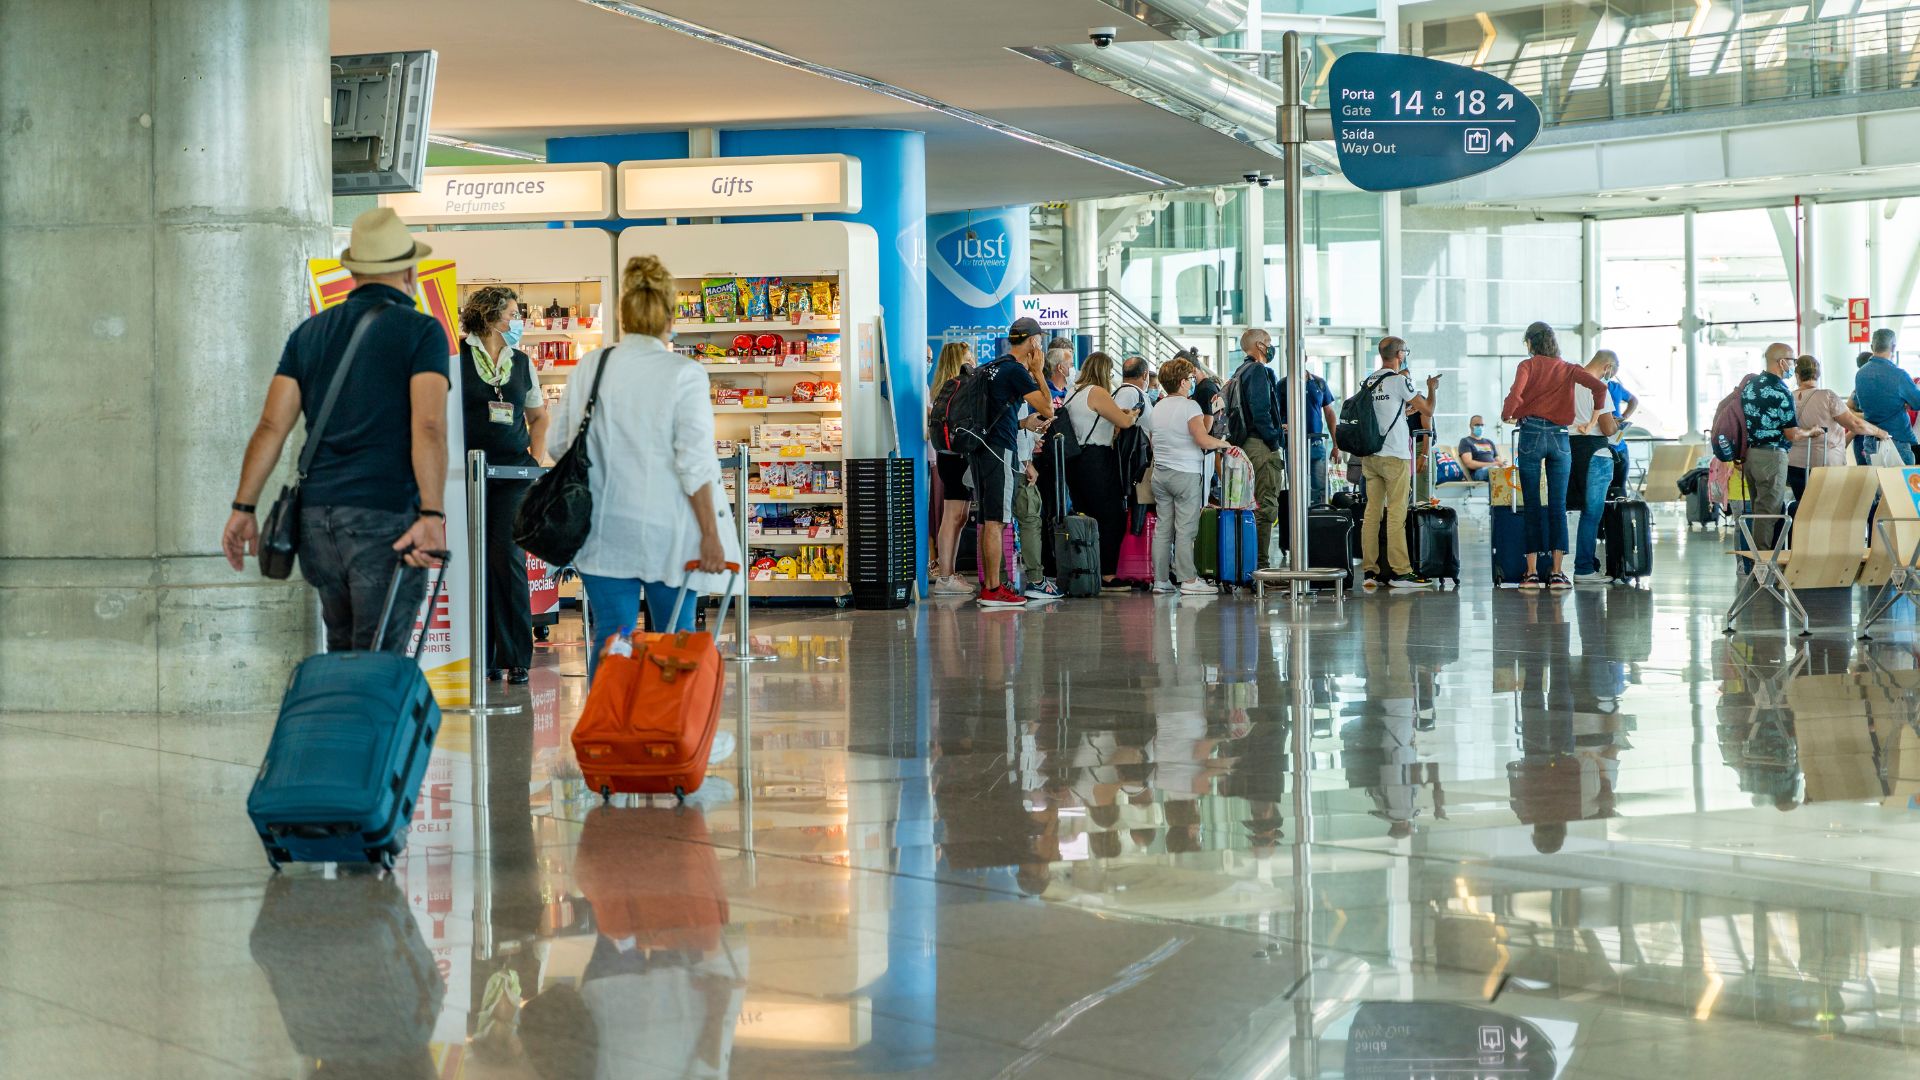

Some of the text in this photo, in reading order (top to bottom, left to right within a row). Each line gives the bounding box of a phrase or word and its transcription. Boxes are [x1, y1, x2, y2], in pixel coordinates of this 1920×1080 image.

[1342, 88, 1486, 115] Porta 14 a 18
[1342, 105, 1446, 116] Gate to
[1342, 128, 1375, 140] Saída
[1342, 143, 1397, 156] Way Out
[445, 178, 545, 199] Fragrances
[711, 176, 754, 197] Gifts
[445, 199, 506, 214] Perfumes
[954, 232, 1006, 266] just
[1022, 297, 1040, 310] Wi
[1039, 307, 1069, 319] Zink
[528, 574, 555, 598] peciais
